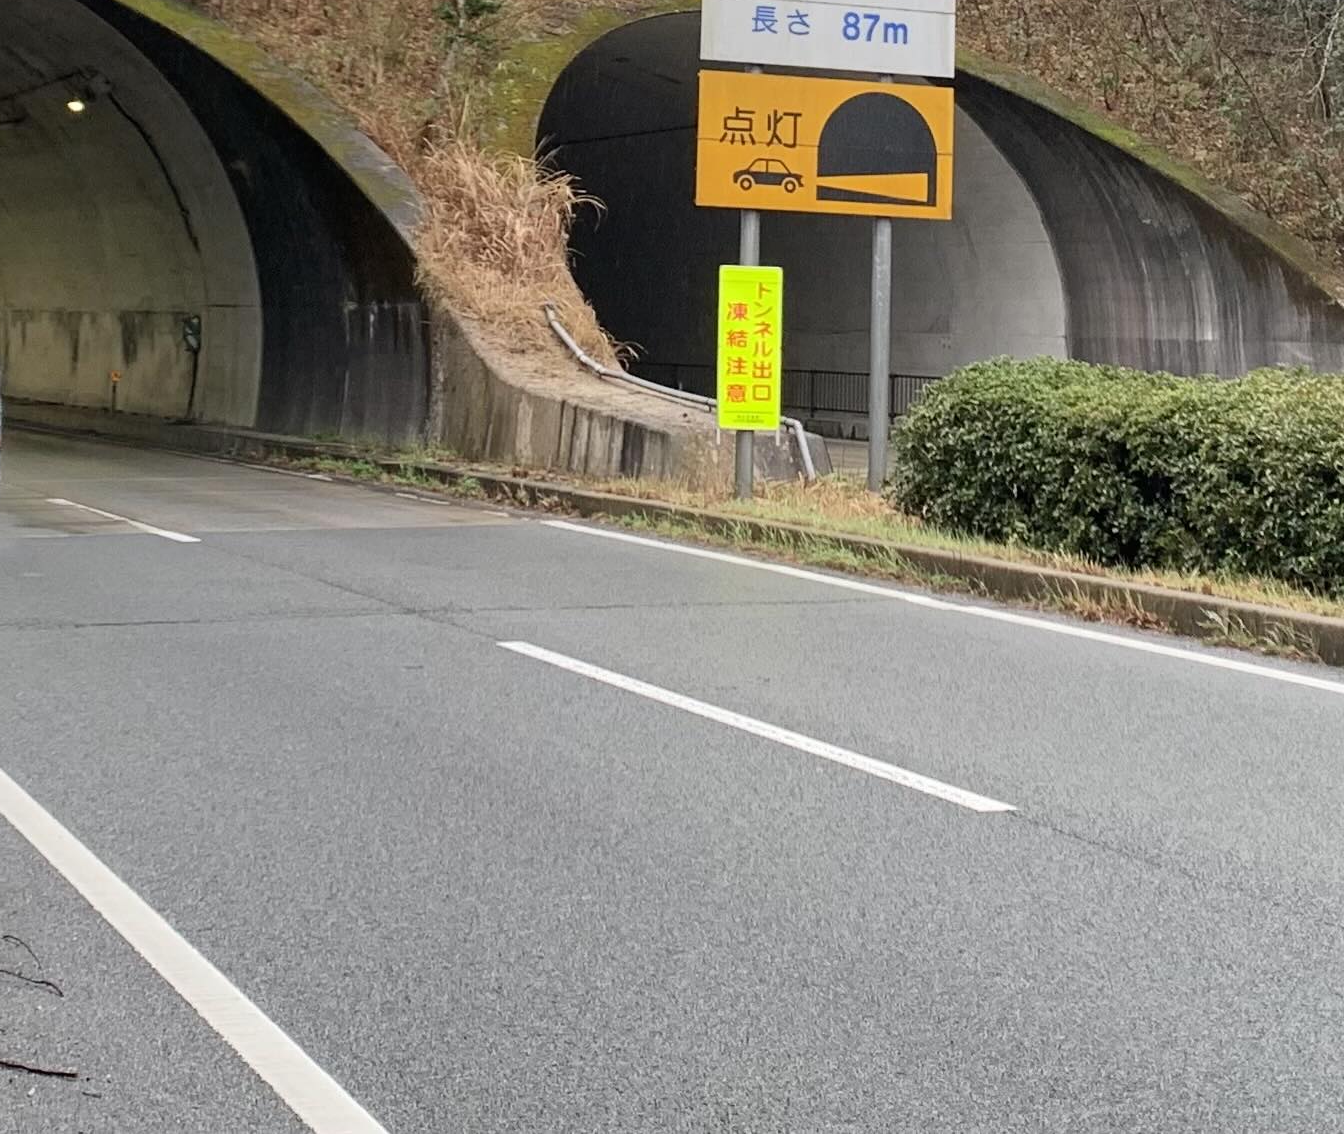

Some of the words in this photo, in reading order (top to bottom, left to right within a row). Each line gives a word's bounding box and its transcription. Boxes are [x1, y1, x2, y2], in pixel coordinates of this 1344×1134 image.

[751, 6, 811, 36] 長さ
[842, 12, 908, 44] 87m
[719, 106, 802, 148] 点灯
[725, 302, 749, 403] 凍結注意
[752, 282, 773, 402] トンネル出口
